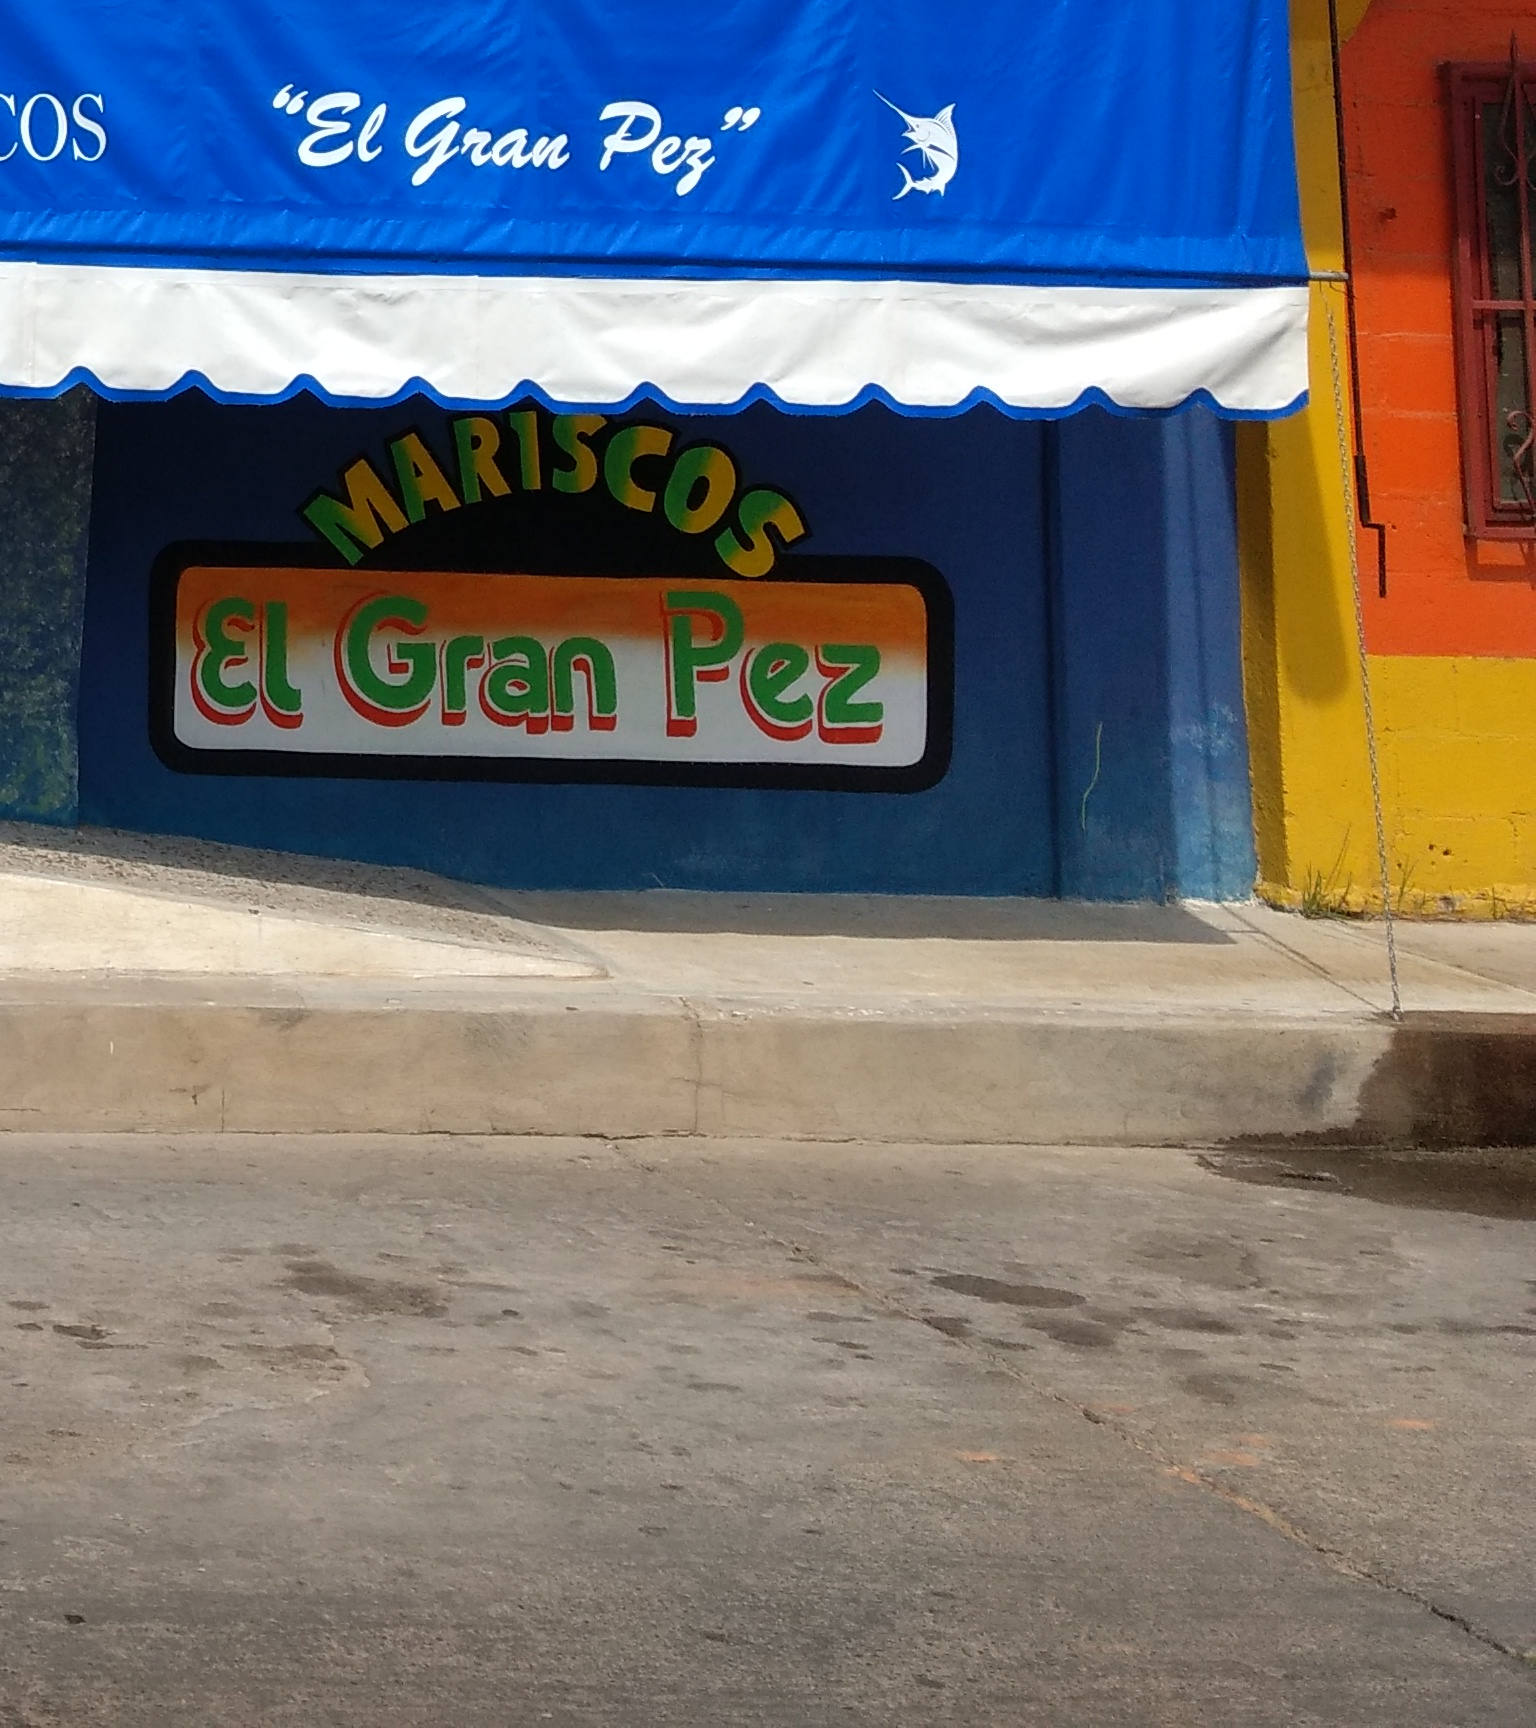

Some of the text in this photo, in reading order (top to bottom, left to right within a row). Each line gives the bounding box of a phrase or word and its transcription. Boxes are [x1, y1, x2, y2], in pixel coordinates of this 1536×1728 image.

[272, 84, 387, 167] “El
[404, 96, 570, 186] Gran
[599, 101, 761, 197] Pez”
[303, 410, 806, 578] MARISCOS
[191, 590, 884, 744] El Gran Pez
